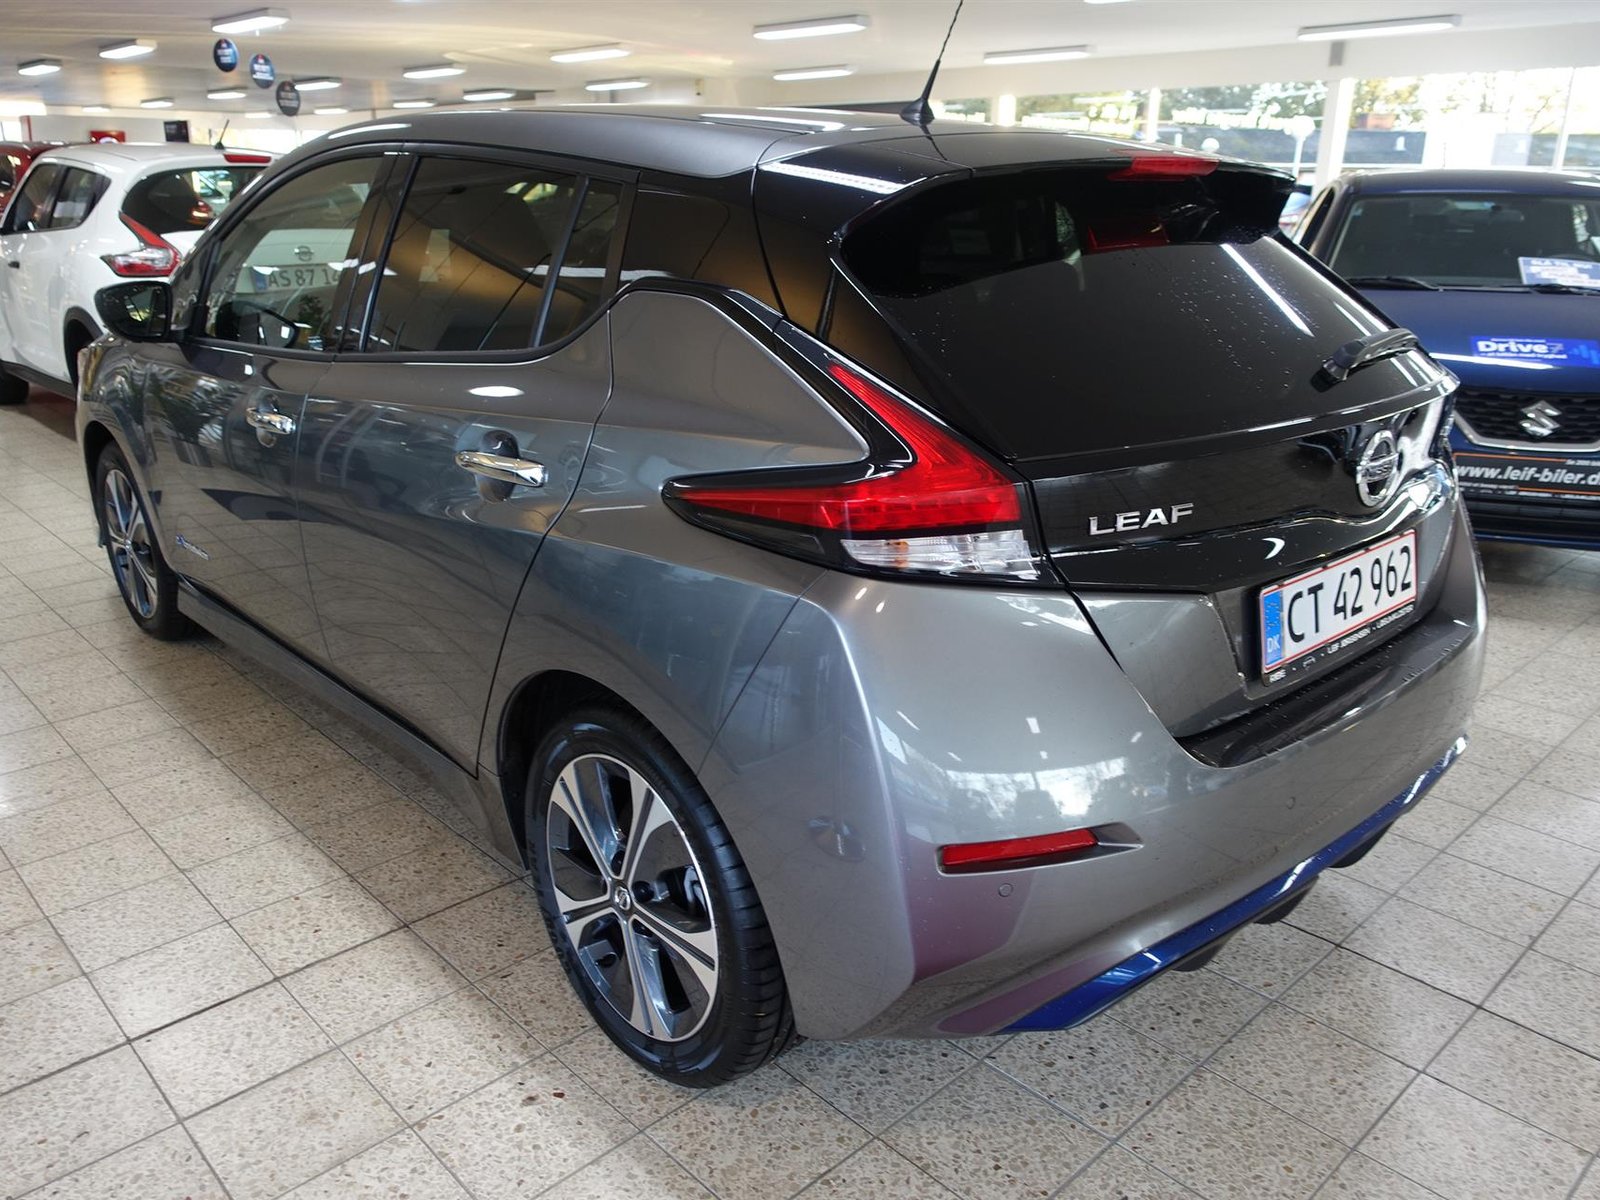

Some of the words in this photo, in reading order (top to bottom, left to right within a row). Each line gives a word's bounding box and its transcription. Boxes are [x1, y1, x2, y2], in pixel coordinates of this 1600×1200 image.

[268, 270, 291, 288] AS
[295, 269, 315, 287] 87
[1089, 502, 1194, 535] LEAF
[1288, 582, 1324, 643] CT
[1334, 567, 1363, 620] 42
[1370, 545, 1412, 607] 962
[1267, 634, 1281, 653] DK
